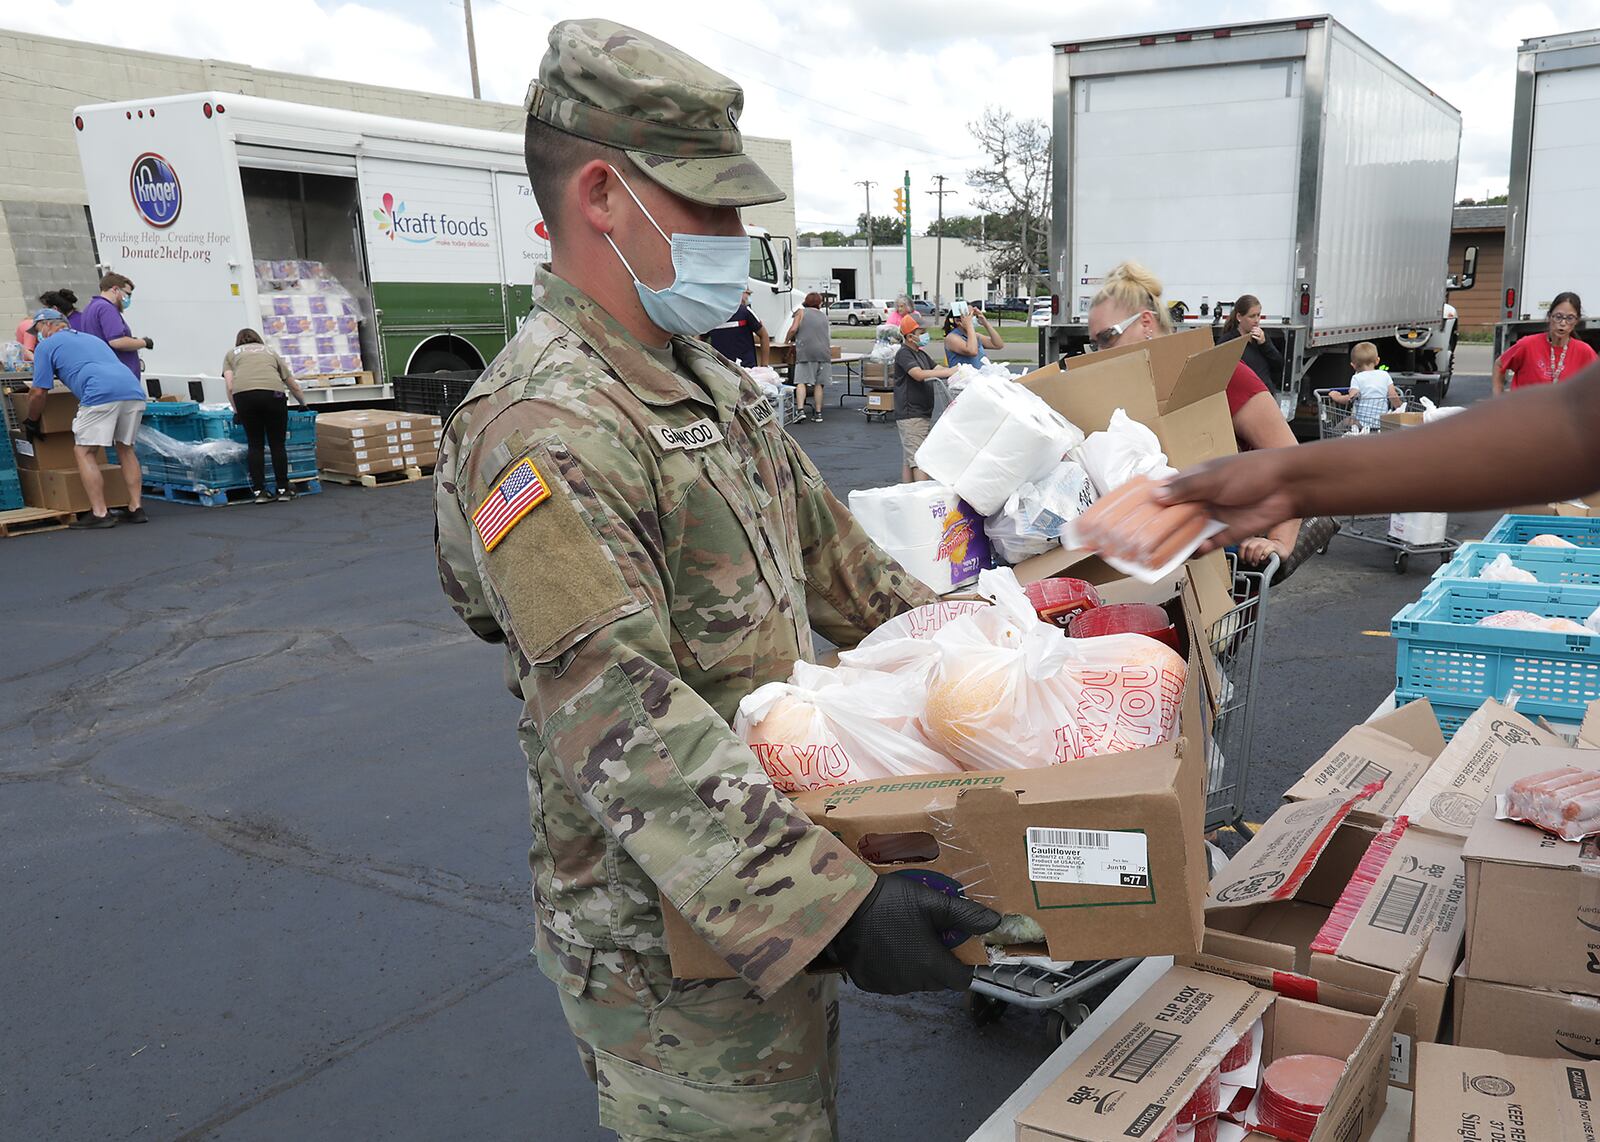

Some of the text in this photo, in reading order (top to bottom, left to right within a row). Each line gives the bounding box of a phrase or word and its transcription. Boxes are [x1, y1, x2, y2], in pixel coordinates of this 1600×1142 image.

[136, 165, 176, 217] Kroger
[392, 211, 488, 237] kraft foods
[100, 232, 139, 245] Providing
[207, 231, 231, 246] Hope
[122, 246, 212, 263] Donate2help.org
[522, 251, 548, 260] Second
[1452, 772, 1466, 789] KEEP
[1463, 741, 1492, 777] REFRIGERATED
[831, 785, 874, 797] KEEP
[876, 776, 1006, 793] REFRIGERATED
[1031, 846, 1081, 856] Cauliflower
[1446, 889, 1464, 904] BOX
[1155, 985, 1199, 1021] FLIP BOX
[1180, 1004, 1195, 1017] EASY
[1192, 992, 1207, 1005] OPEN
[1182, 1009, 1199, 1025] QUICK
[1556, 1029, 1592, 1043] Company
[1157, 1096, 1169, 1105] DO
[1164, 1086, 1176, 1098] NOT
[1174, 1076, 1185, 1087] USE
[1181, 1061, 1196, 1078] KNIFE
[1067, 1086, 1095, 1105] BAR
[1578, 1100, 1588, 1110] DO
[1507, 1103, 1523, 1126] KEEP
[1580, 1110, 1591, 1122] NOT
[1490, 1120, 1504, 1131] 37
